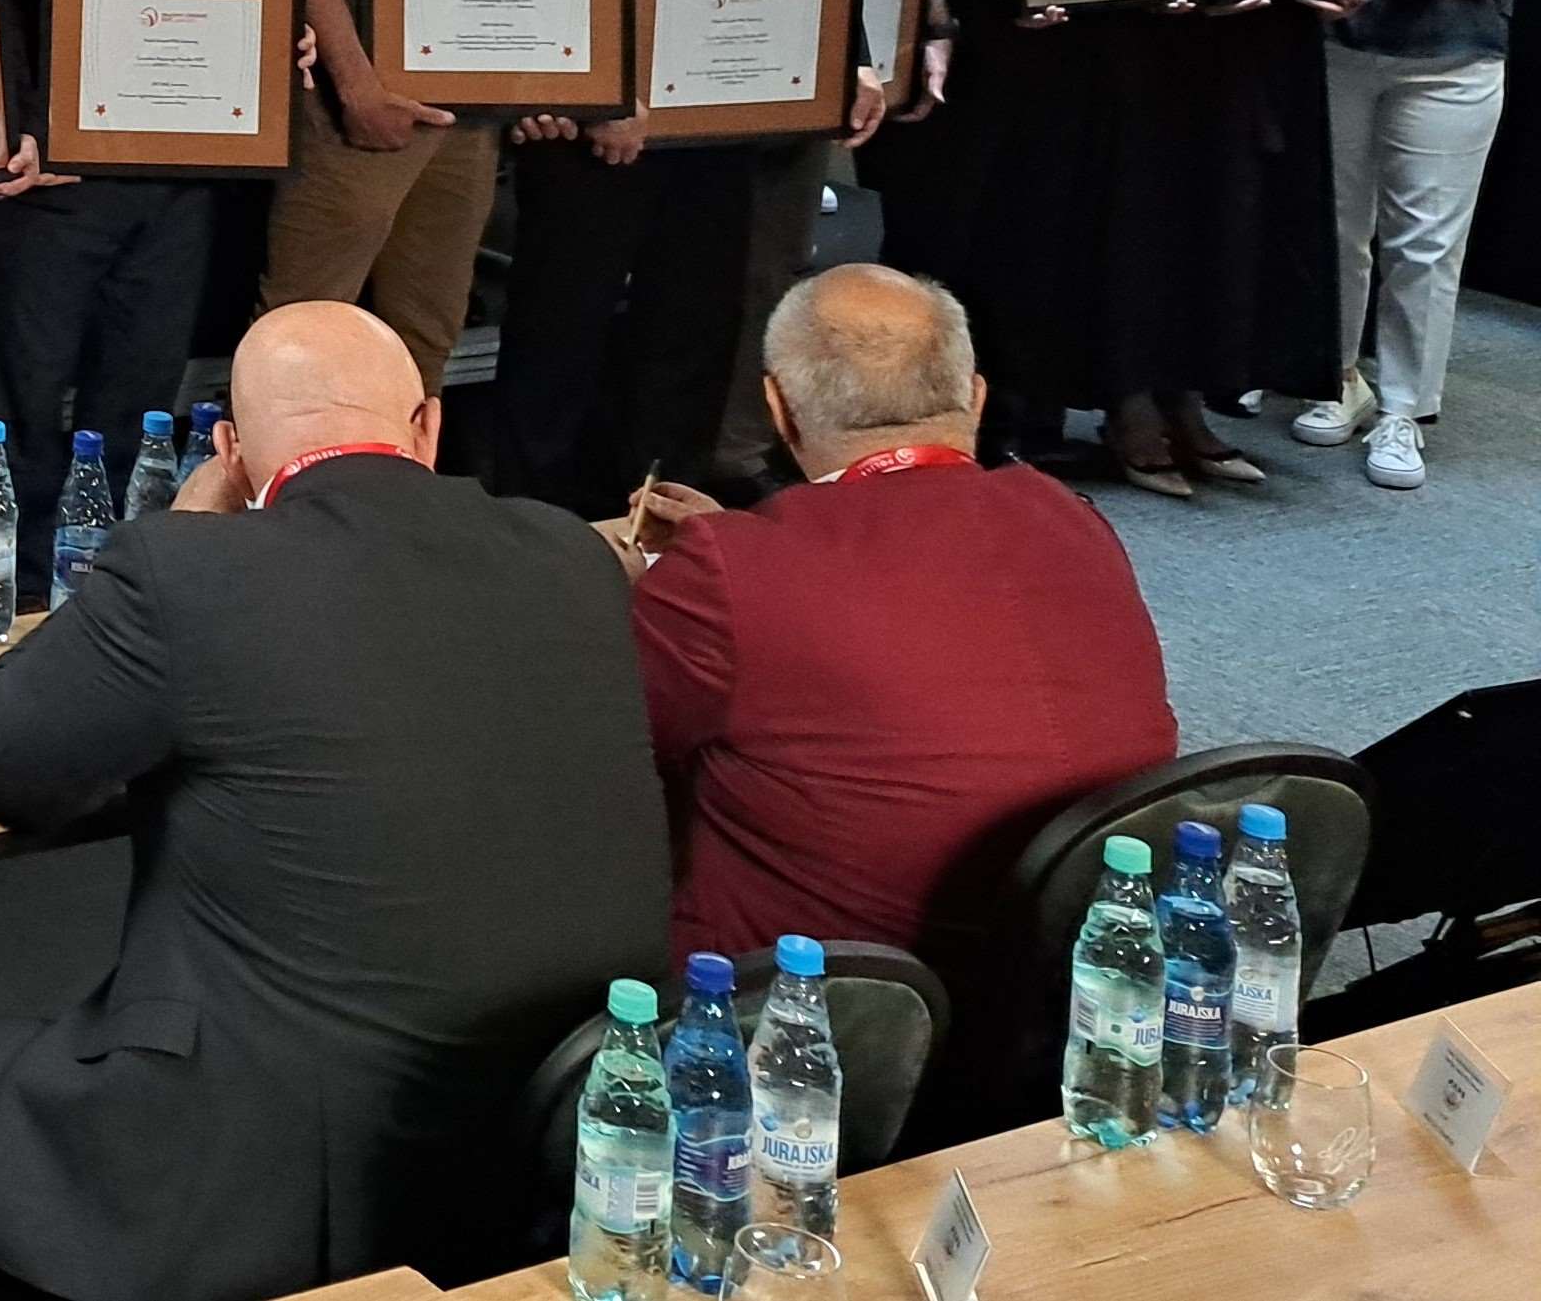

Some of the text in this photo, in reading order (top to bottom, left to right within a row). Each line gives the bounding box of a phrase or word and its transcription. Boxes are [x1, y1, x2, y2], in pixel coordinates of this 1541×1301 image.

[1236, 982, 1273, 1001] AJSKA
[1167, 998, 1222, 1020] JURAJSKA
[1133, 1024, 1163, 1046] JURA
[761, 1136, 835, 1165] JURAJSKA
